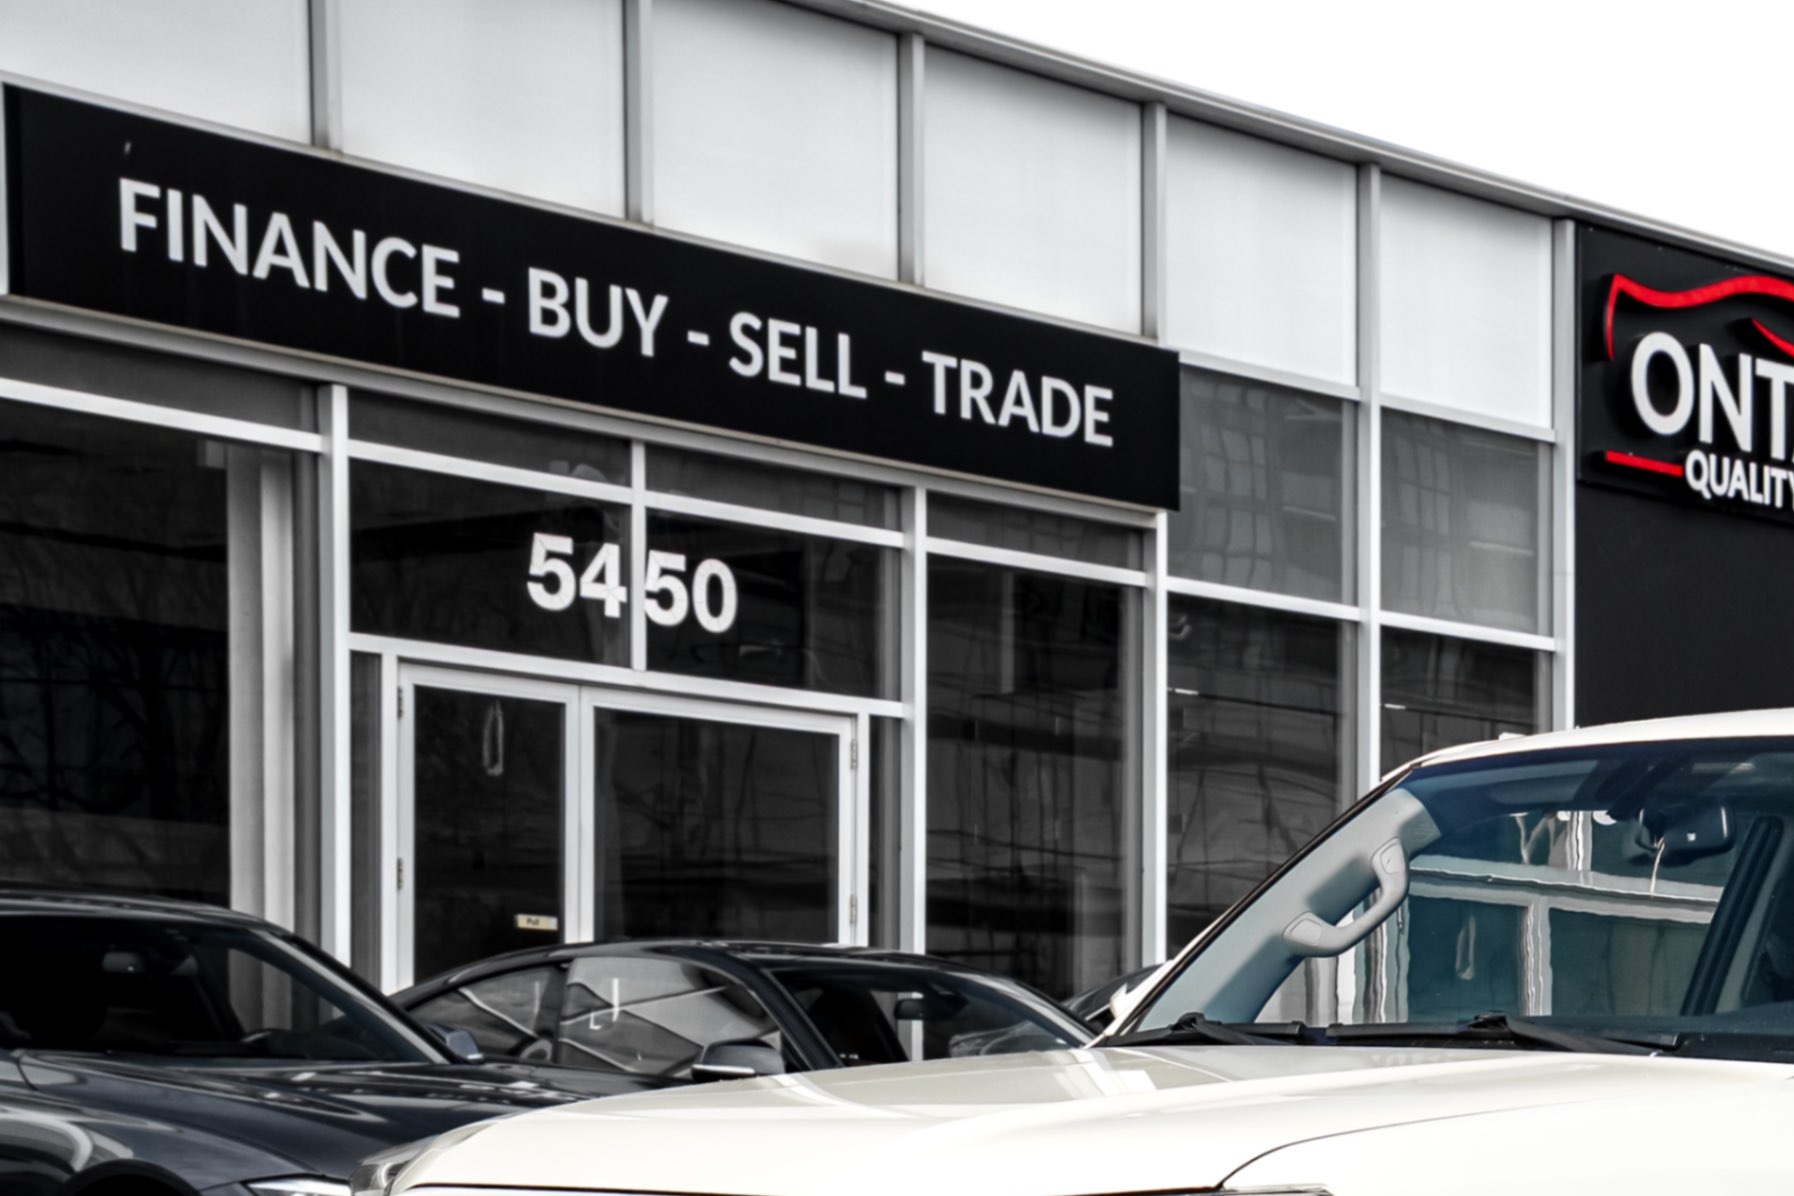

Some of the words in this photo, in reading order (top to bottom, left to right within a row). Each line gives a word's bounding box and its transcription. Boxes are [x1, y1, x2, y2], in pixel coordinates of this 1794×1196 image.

[119, 178, 460, 318] FINANCE
[528, 267, 669, 357] BUY
[729, 311, 867, 399] SELL
[921, 350, 1113, 447] TRADE
[526, 532, 738, 633] 5450
